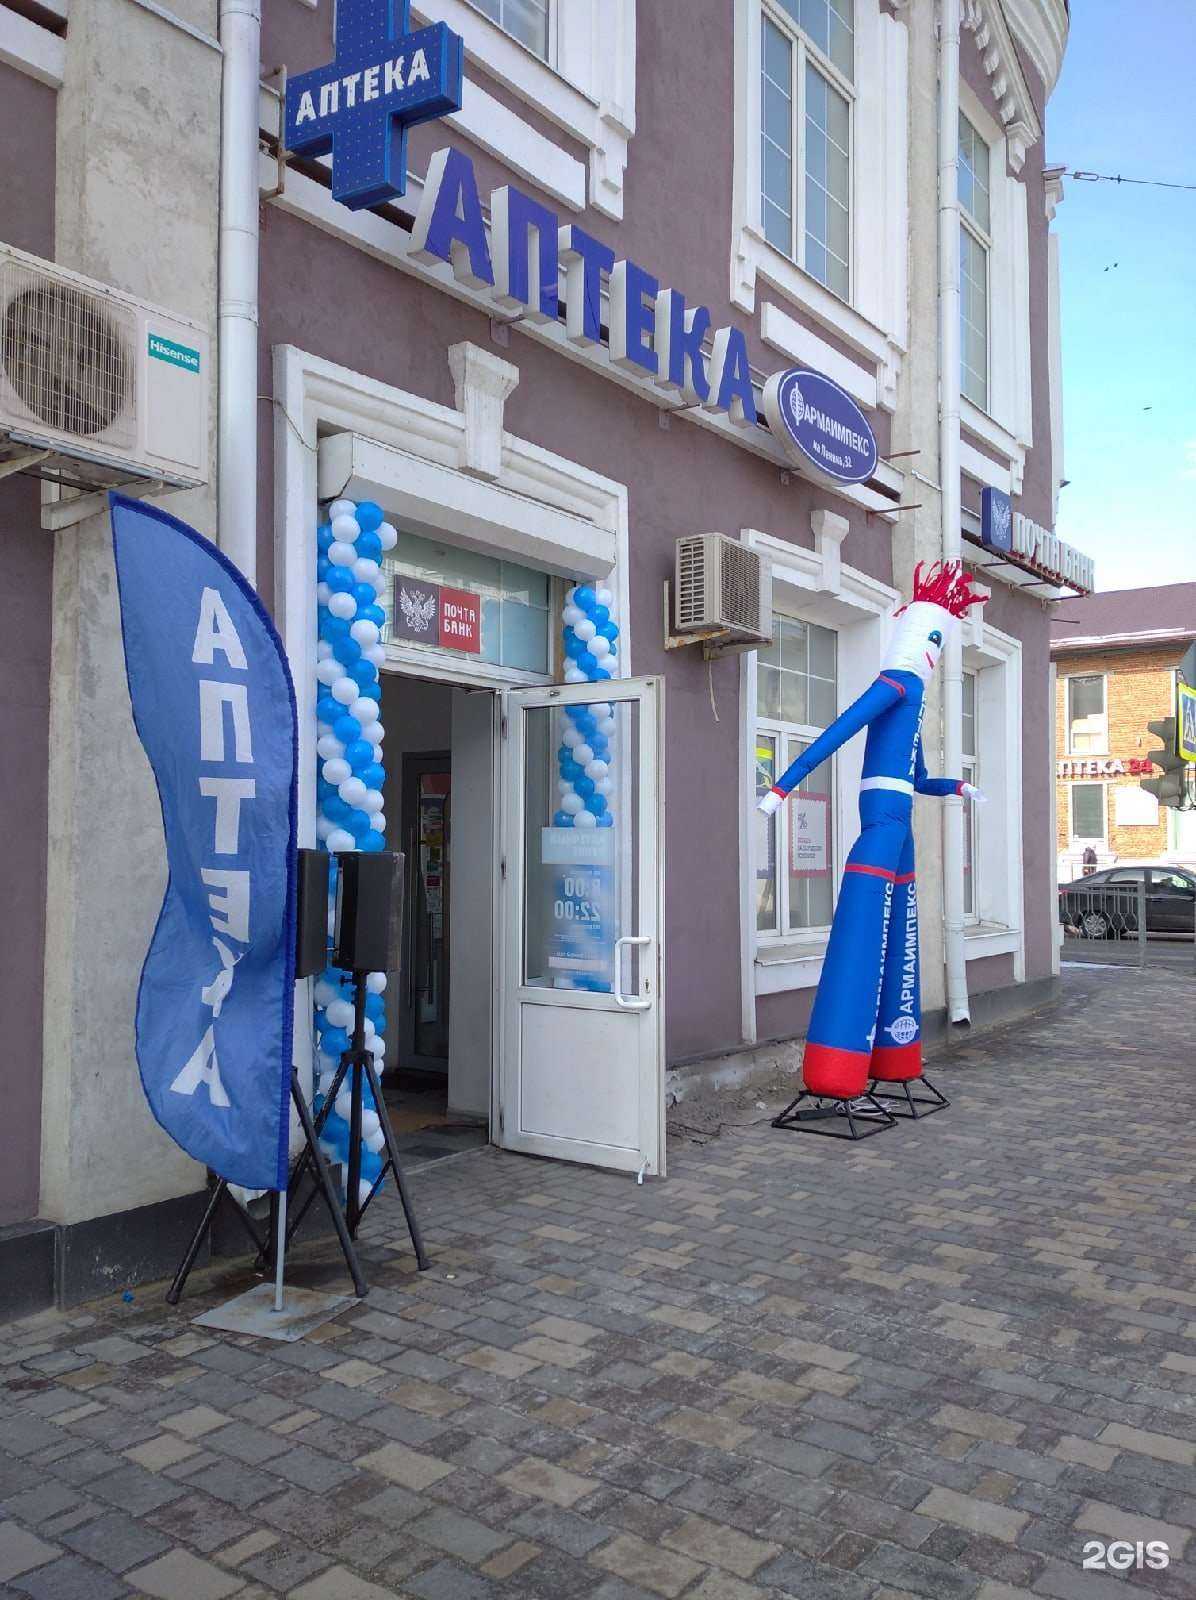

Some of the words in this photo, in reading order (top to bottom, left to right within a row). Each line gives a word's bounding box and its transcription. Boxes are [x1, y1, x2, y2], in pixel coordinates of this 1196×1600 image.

[295, 48, 430, 126] АПТЕКА
[408, 146, 758, 430] АПТЕКА
[149, 340, 199, 367] Hisense
[444, 602, 476, 623] ПОЧТА
[444, 618, 473, 638] БАНК
[1056, 759, 1125, 775] ПТЕКА
